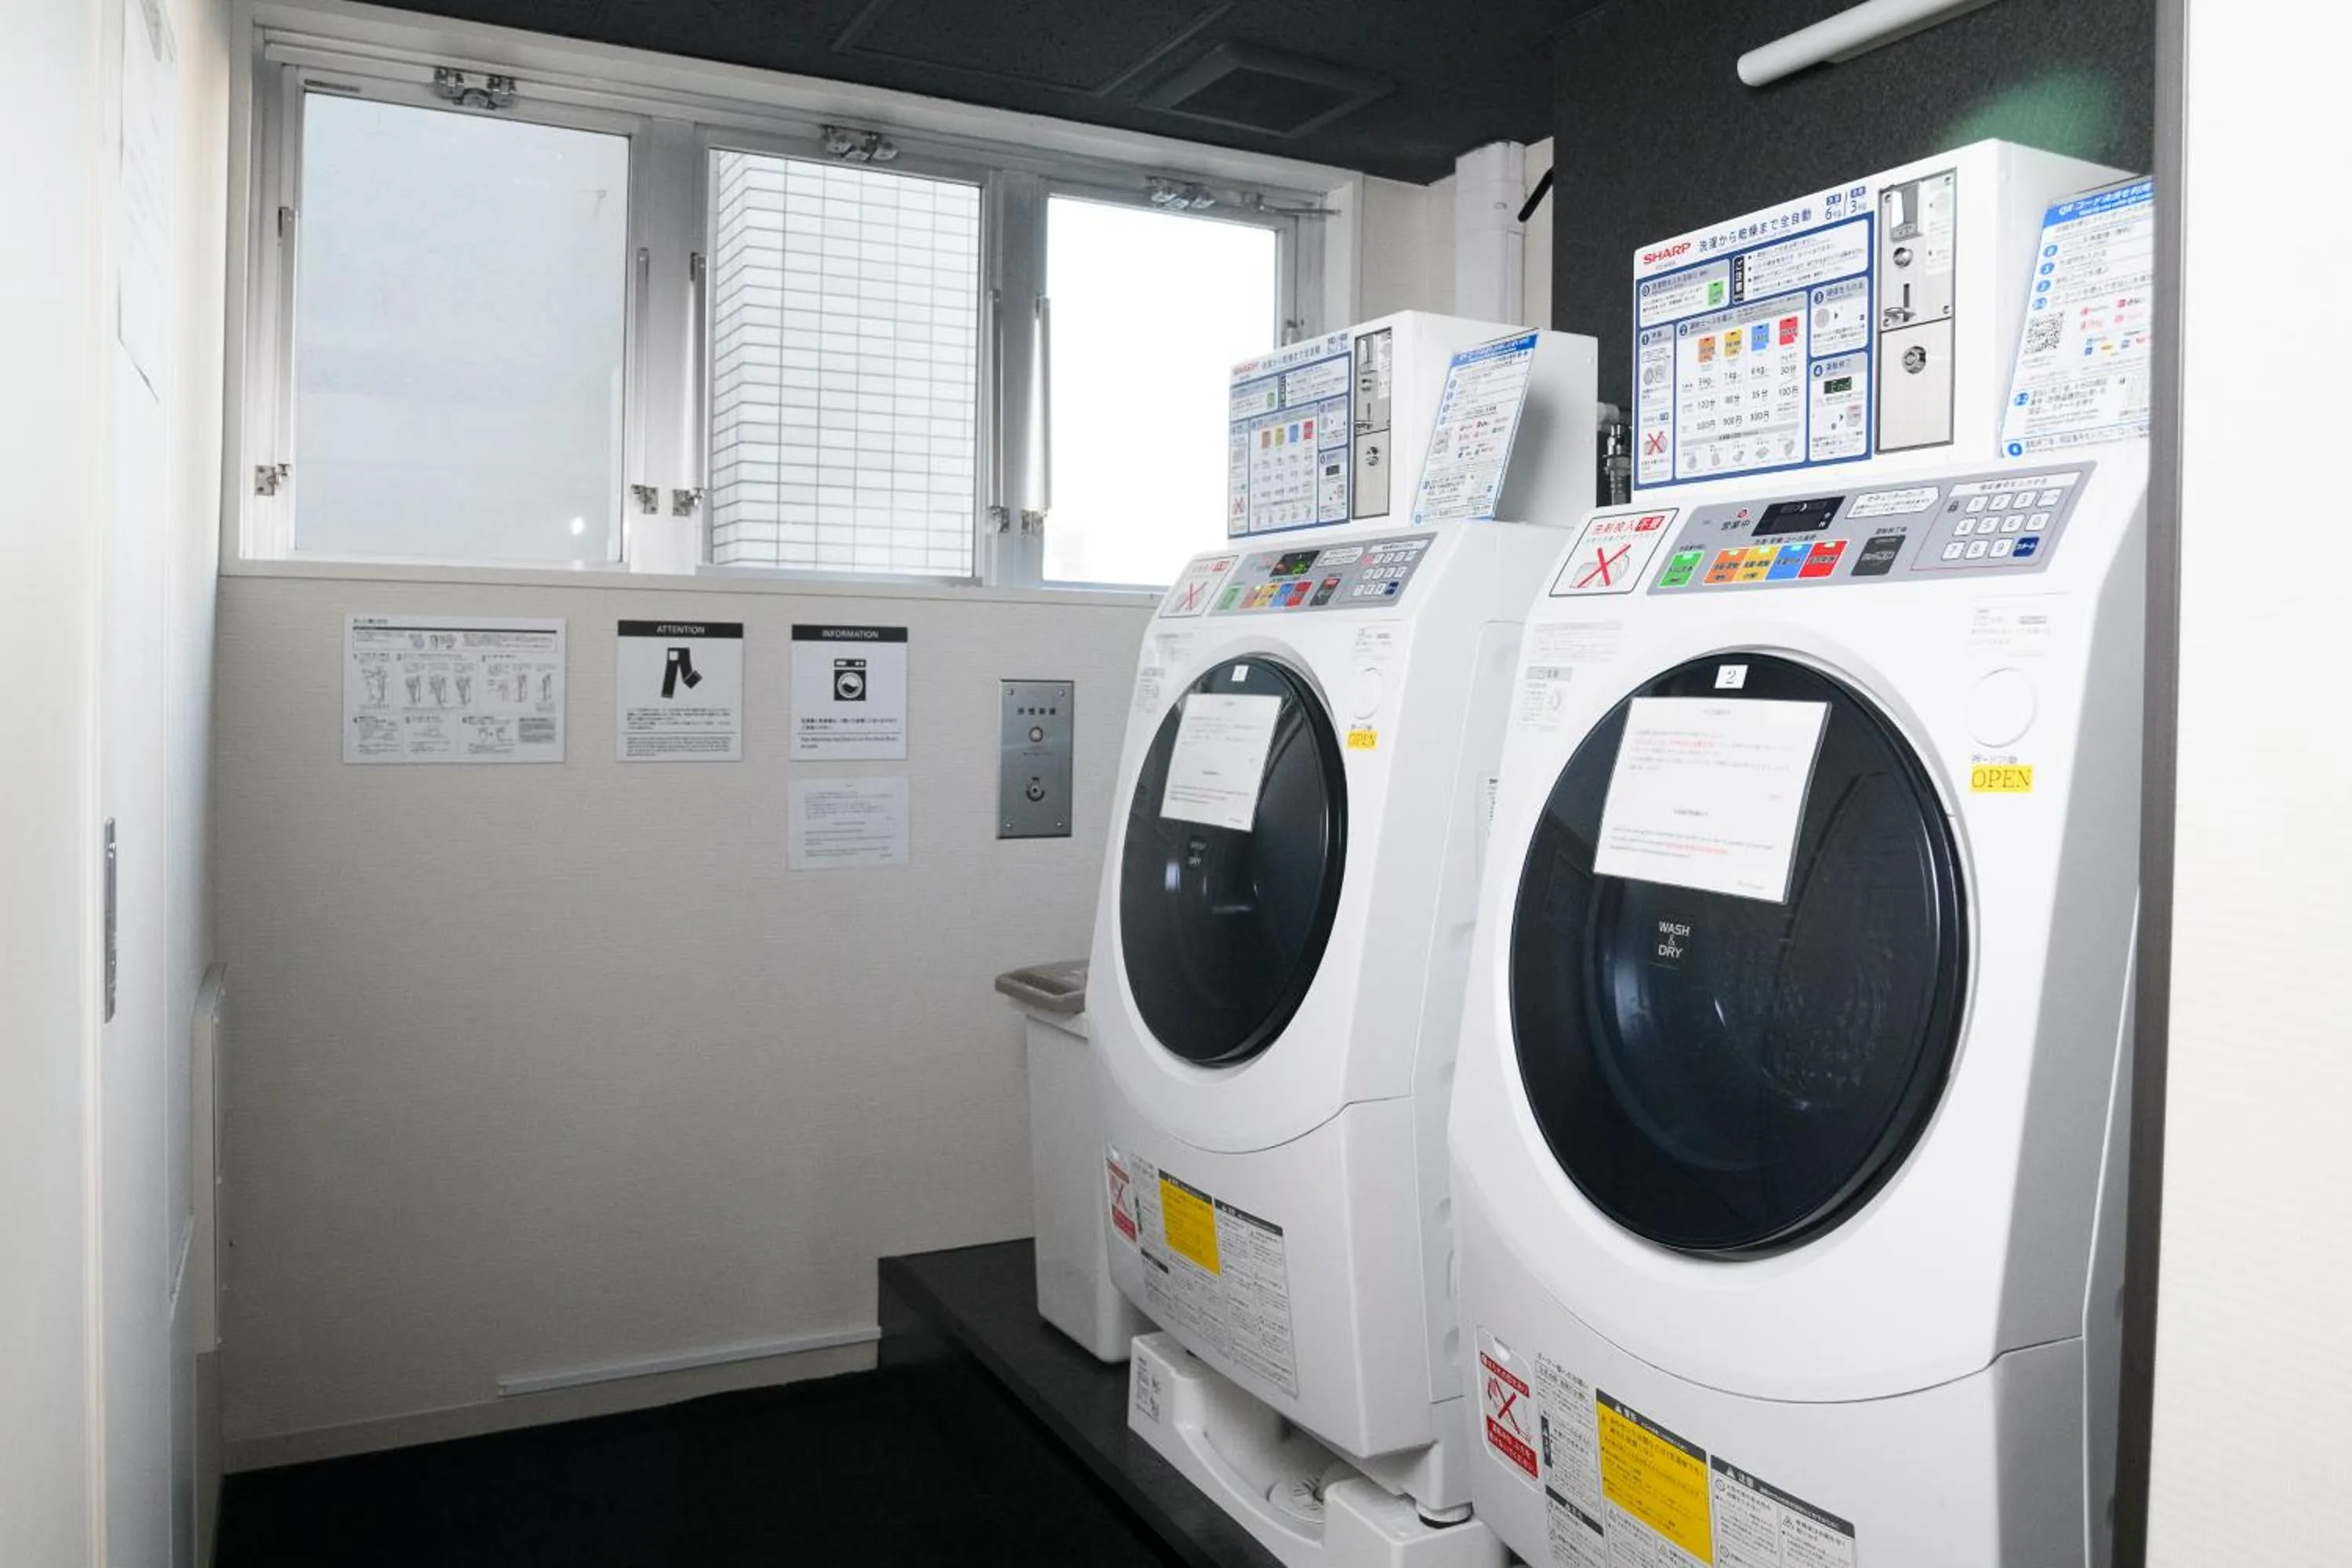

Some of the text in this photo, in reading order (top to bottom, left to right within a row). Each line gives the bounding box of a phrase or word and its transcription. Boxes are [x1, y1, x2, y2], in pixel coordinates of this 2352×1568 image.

[1642, 242, 1691, 265] SHARP
[656, 625, 706, 634] ATTENTION
[822, 629, 879, 638] INFORMATION
[1726, 669, 1737, 684] 2
[1348, 731, 1376, 749] OPEN
[1973, 768, 2032, 788] OPEN
[1658, 921, 1690, 937] WASH
[1658, 944, 1684, 958] DRY
